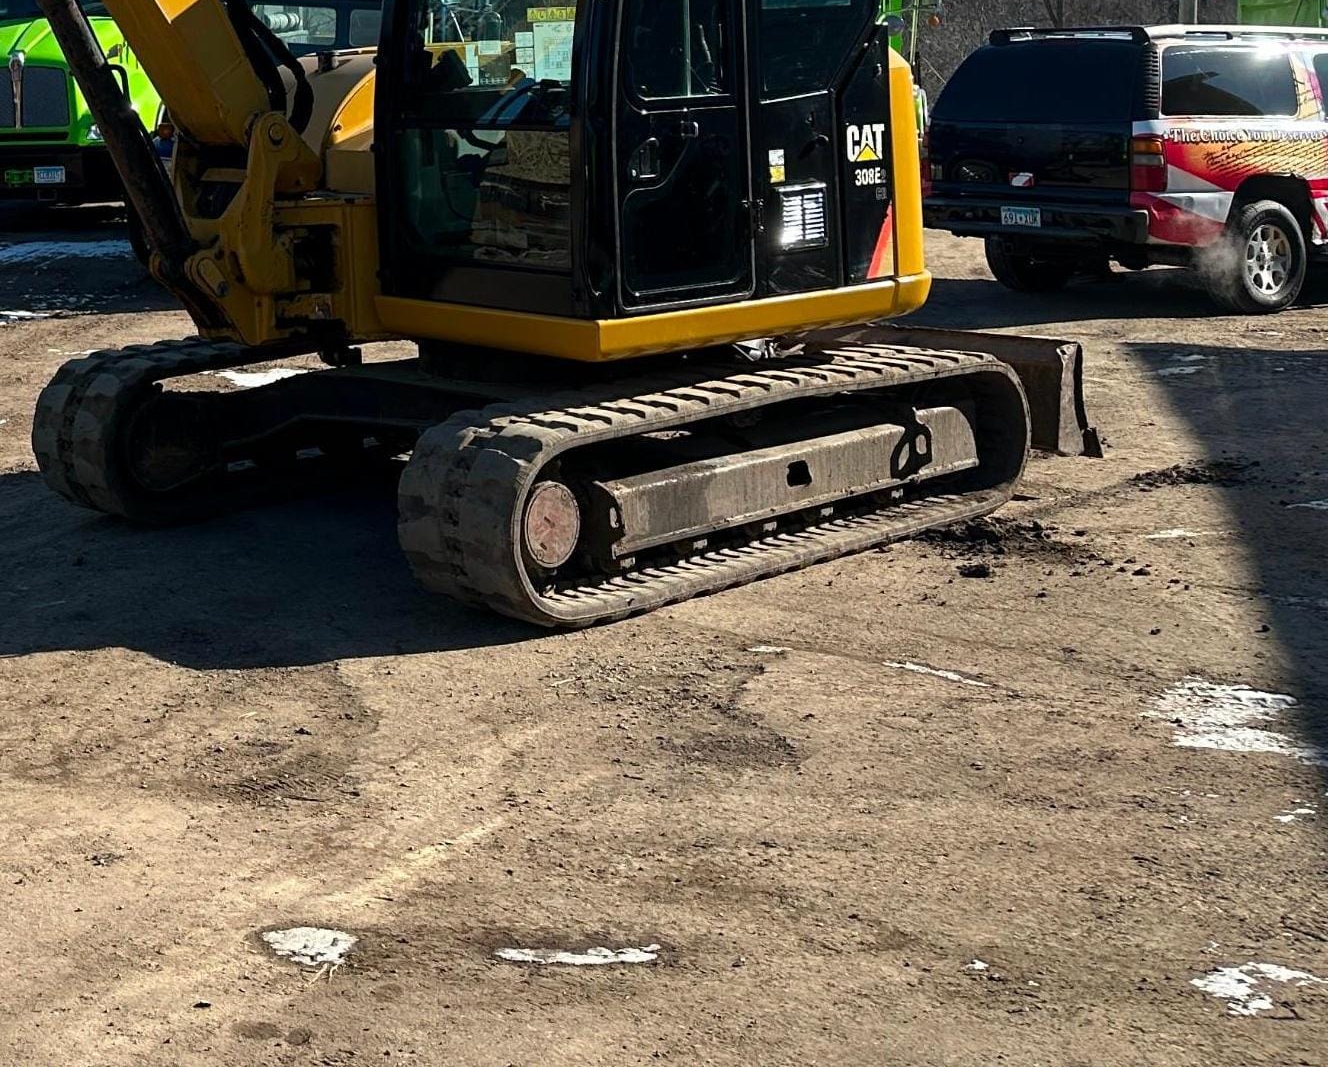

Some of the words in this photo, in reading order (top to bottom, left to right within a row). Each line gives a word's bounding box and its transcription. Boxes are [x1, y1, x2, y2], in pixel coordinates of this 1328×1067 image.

[847, 124, 885, 162] CAT
[1170, 128, 1197, 142] The
[1199, 128, 1242, 142] Choice
